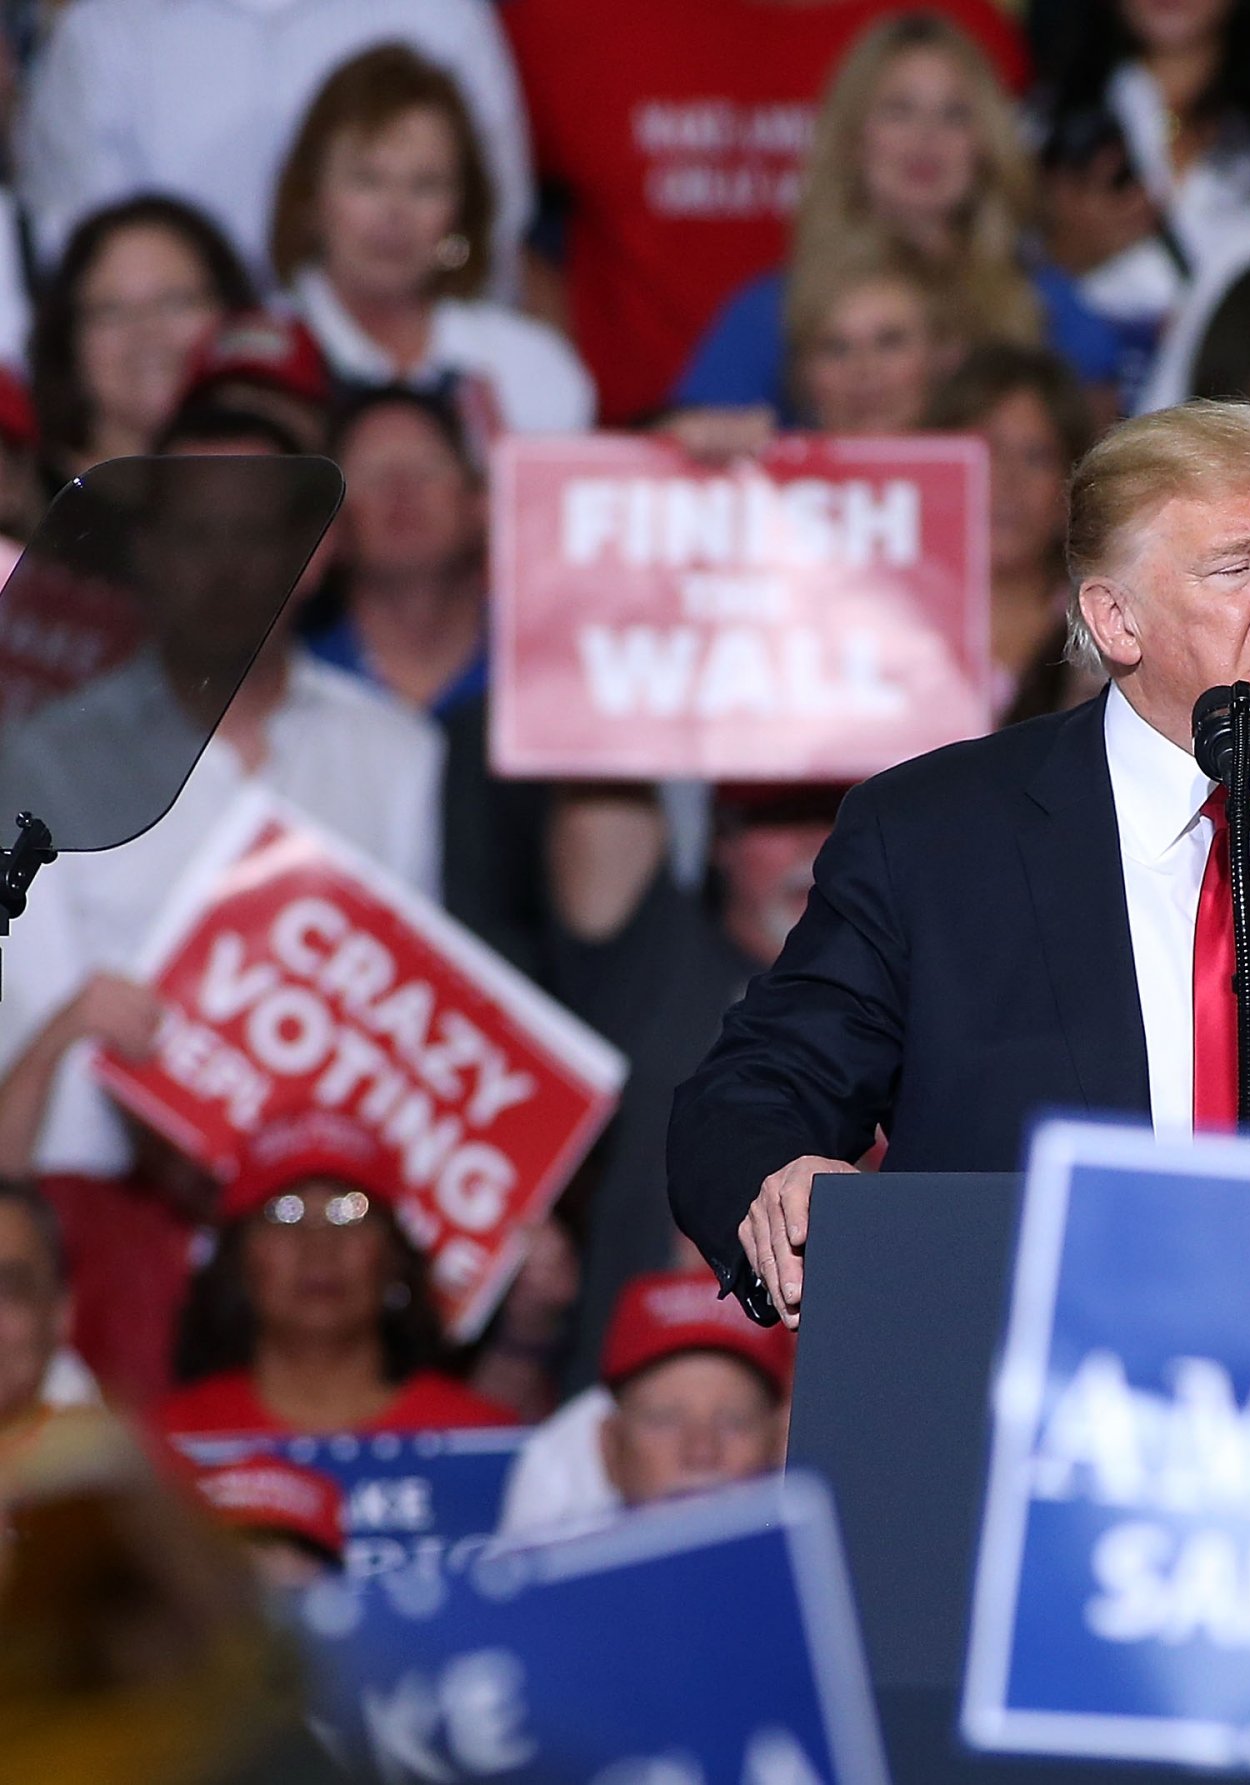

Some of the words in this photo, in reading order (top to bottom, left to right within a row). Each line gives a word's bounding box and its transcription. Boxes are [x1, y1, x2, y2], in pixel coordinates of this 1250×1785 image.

[563, 476, 923, 568] FINISH
[579, 623, 908, 720] WALL
[200, 930, 518, 1233] VOTING
[268, 898, 537, 1130] CRAZY
